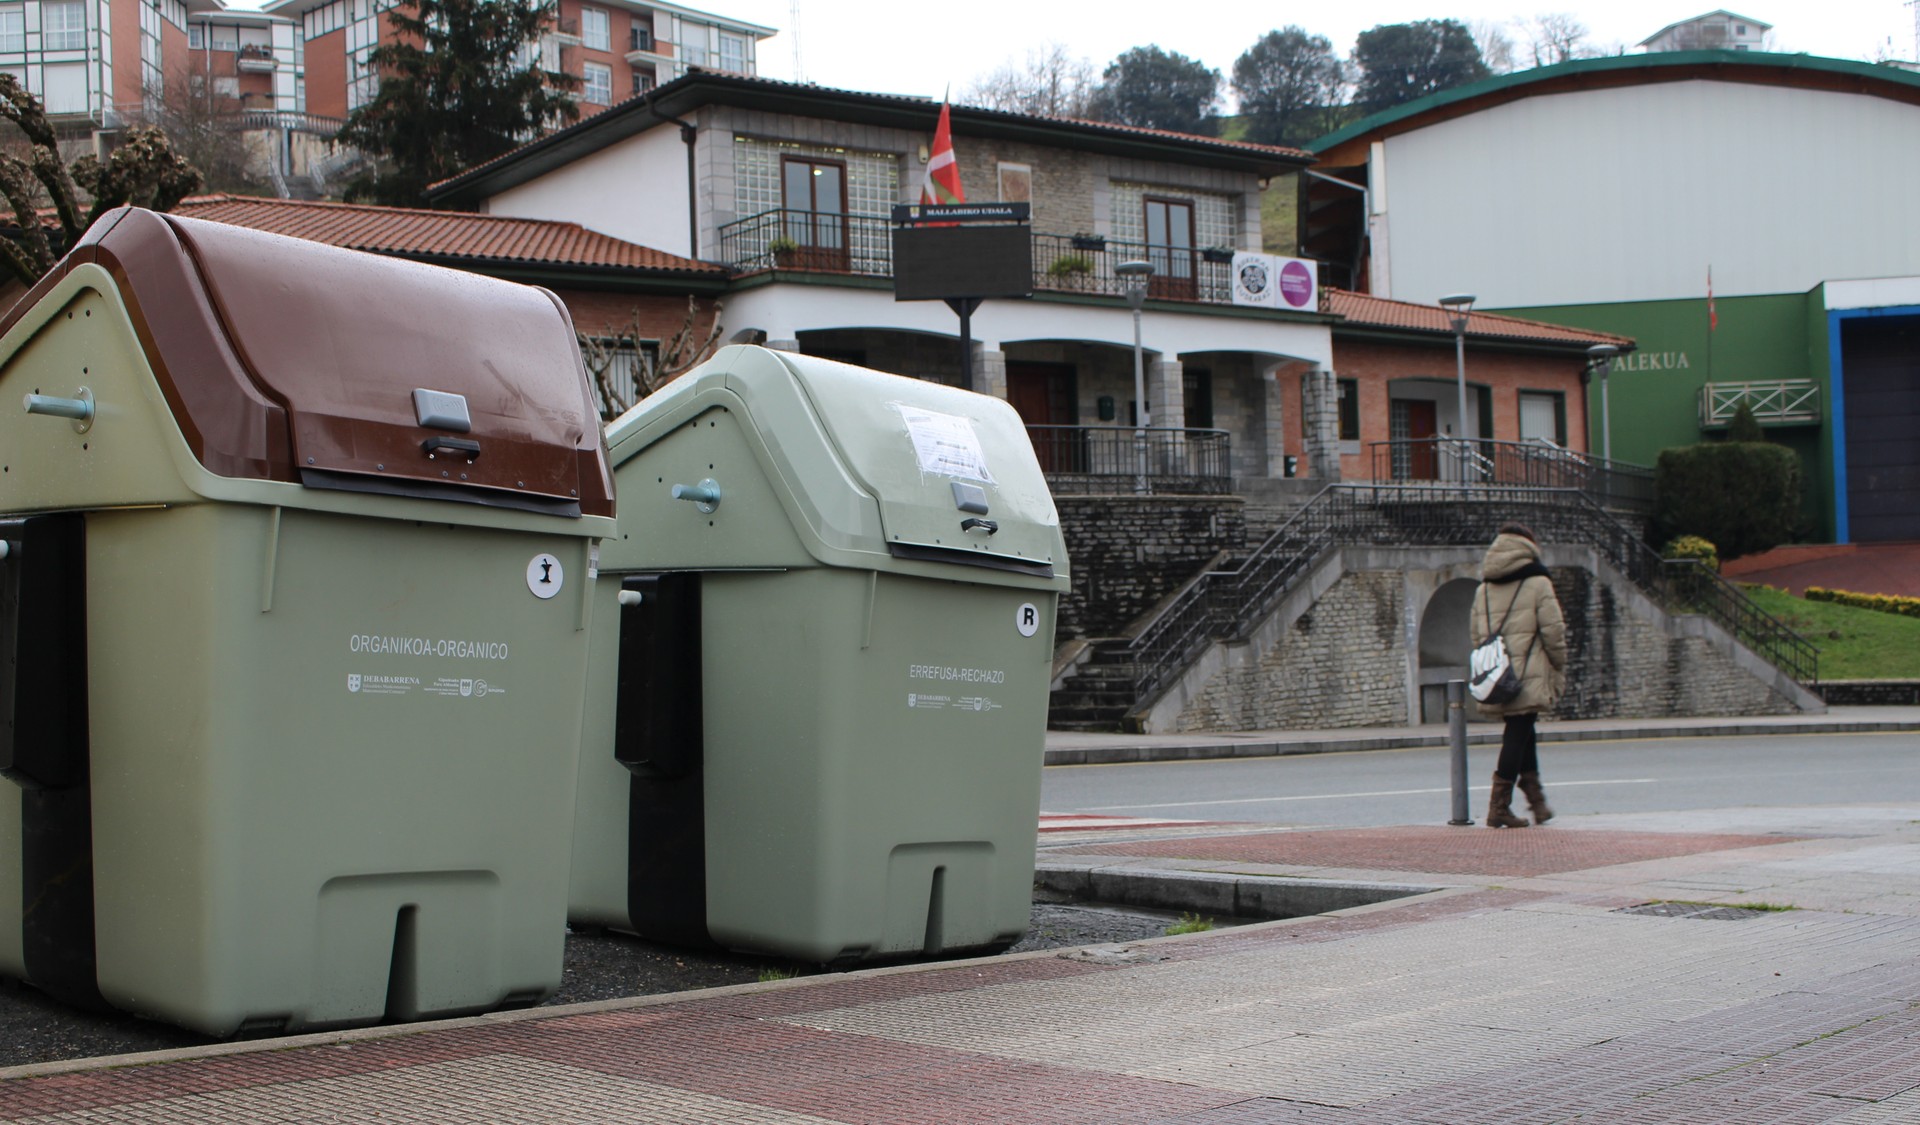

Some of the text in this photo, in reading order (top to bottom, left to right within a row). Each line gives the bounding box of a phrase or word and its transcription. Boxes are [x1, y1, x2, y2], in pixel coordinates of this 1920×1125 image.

[926, 207, 1013, 216] MALLABIKO UDALA
[1613, 352, 1690, 372] ALEKUA
[1023, 607, 1034, 626] R
[350, 634, 508, 660] ORGANIKOA-ORGANICO
[363, 675, 420, 685] DEBABARRENA
[909, 664, 1005, 684] ERREFUSA-RECHAZO
